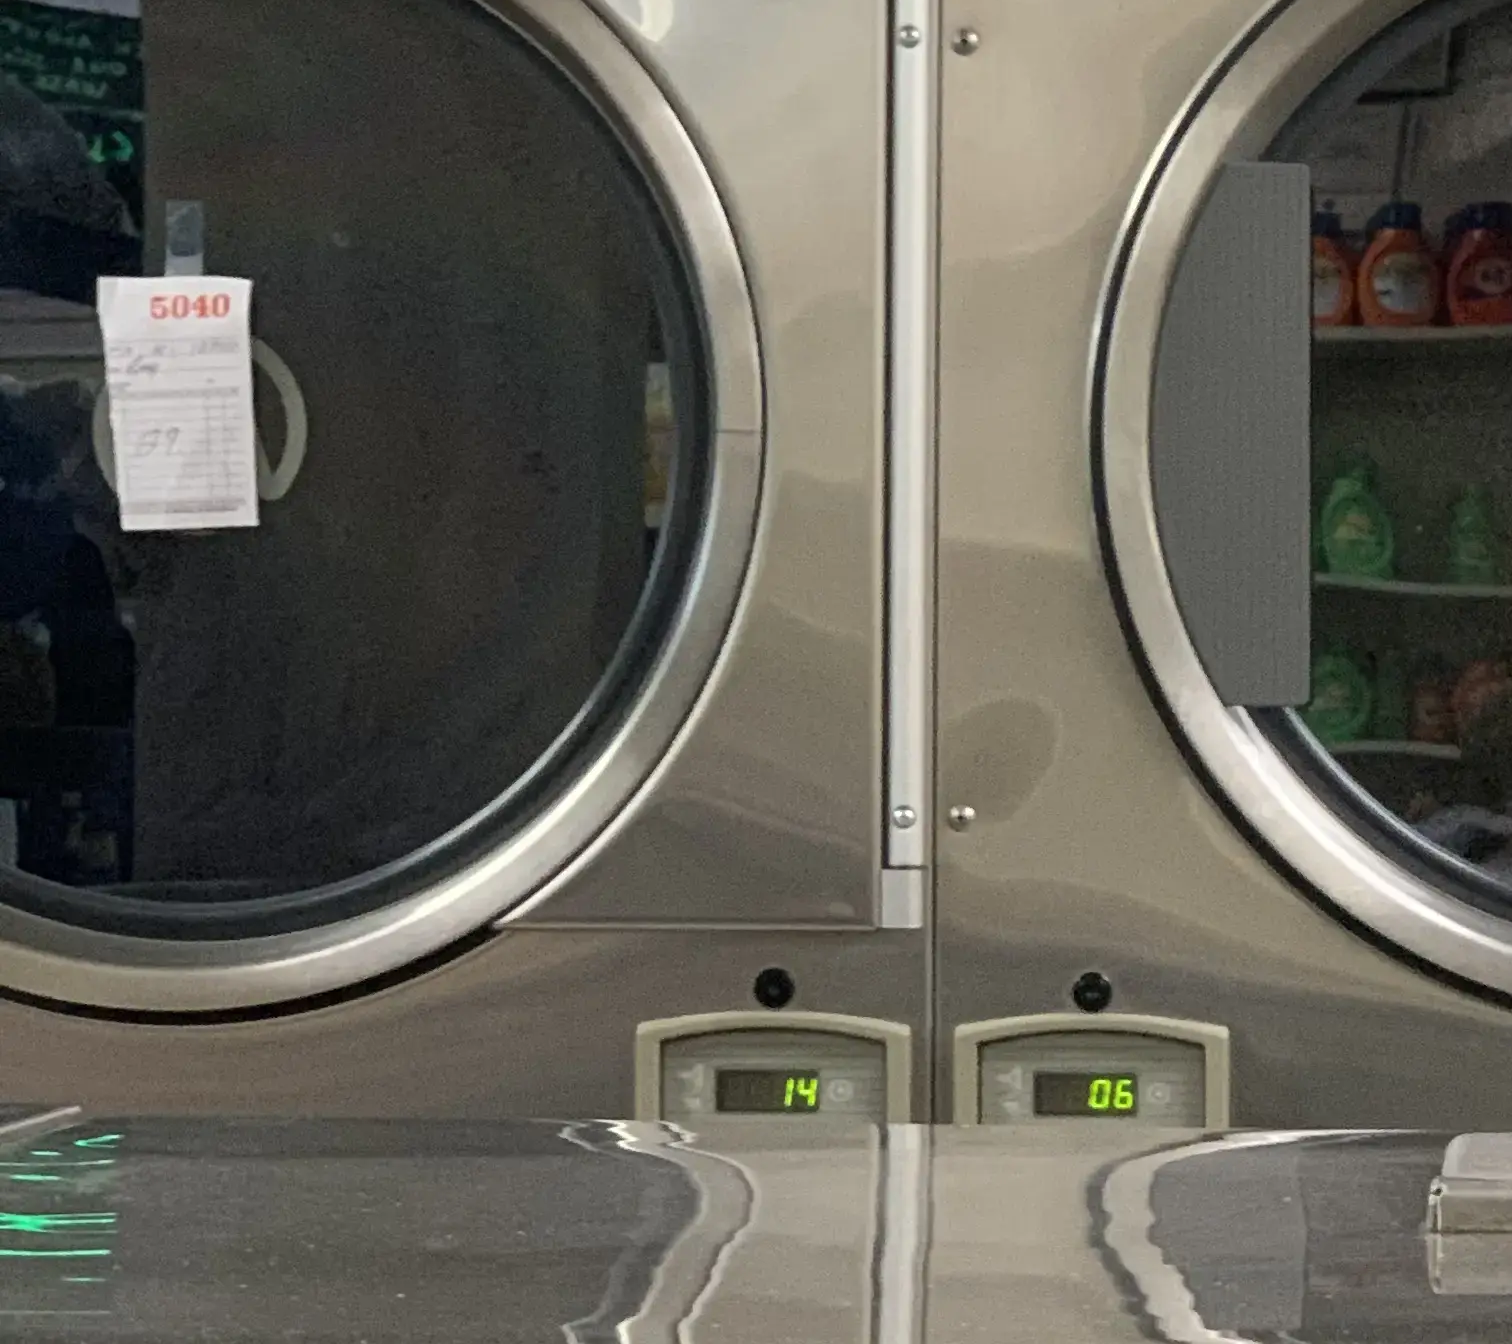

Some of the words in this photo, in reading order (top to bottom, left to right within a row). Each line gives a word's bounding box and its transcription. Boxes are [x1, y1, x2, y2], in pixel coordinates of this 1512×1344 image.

[150, 294, 230, 320] 5040
[785, 1079, 817, 1105] 14
[1088, 1078, 1133, 1109] 06
